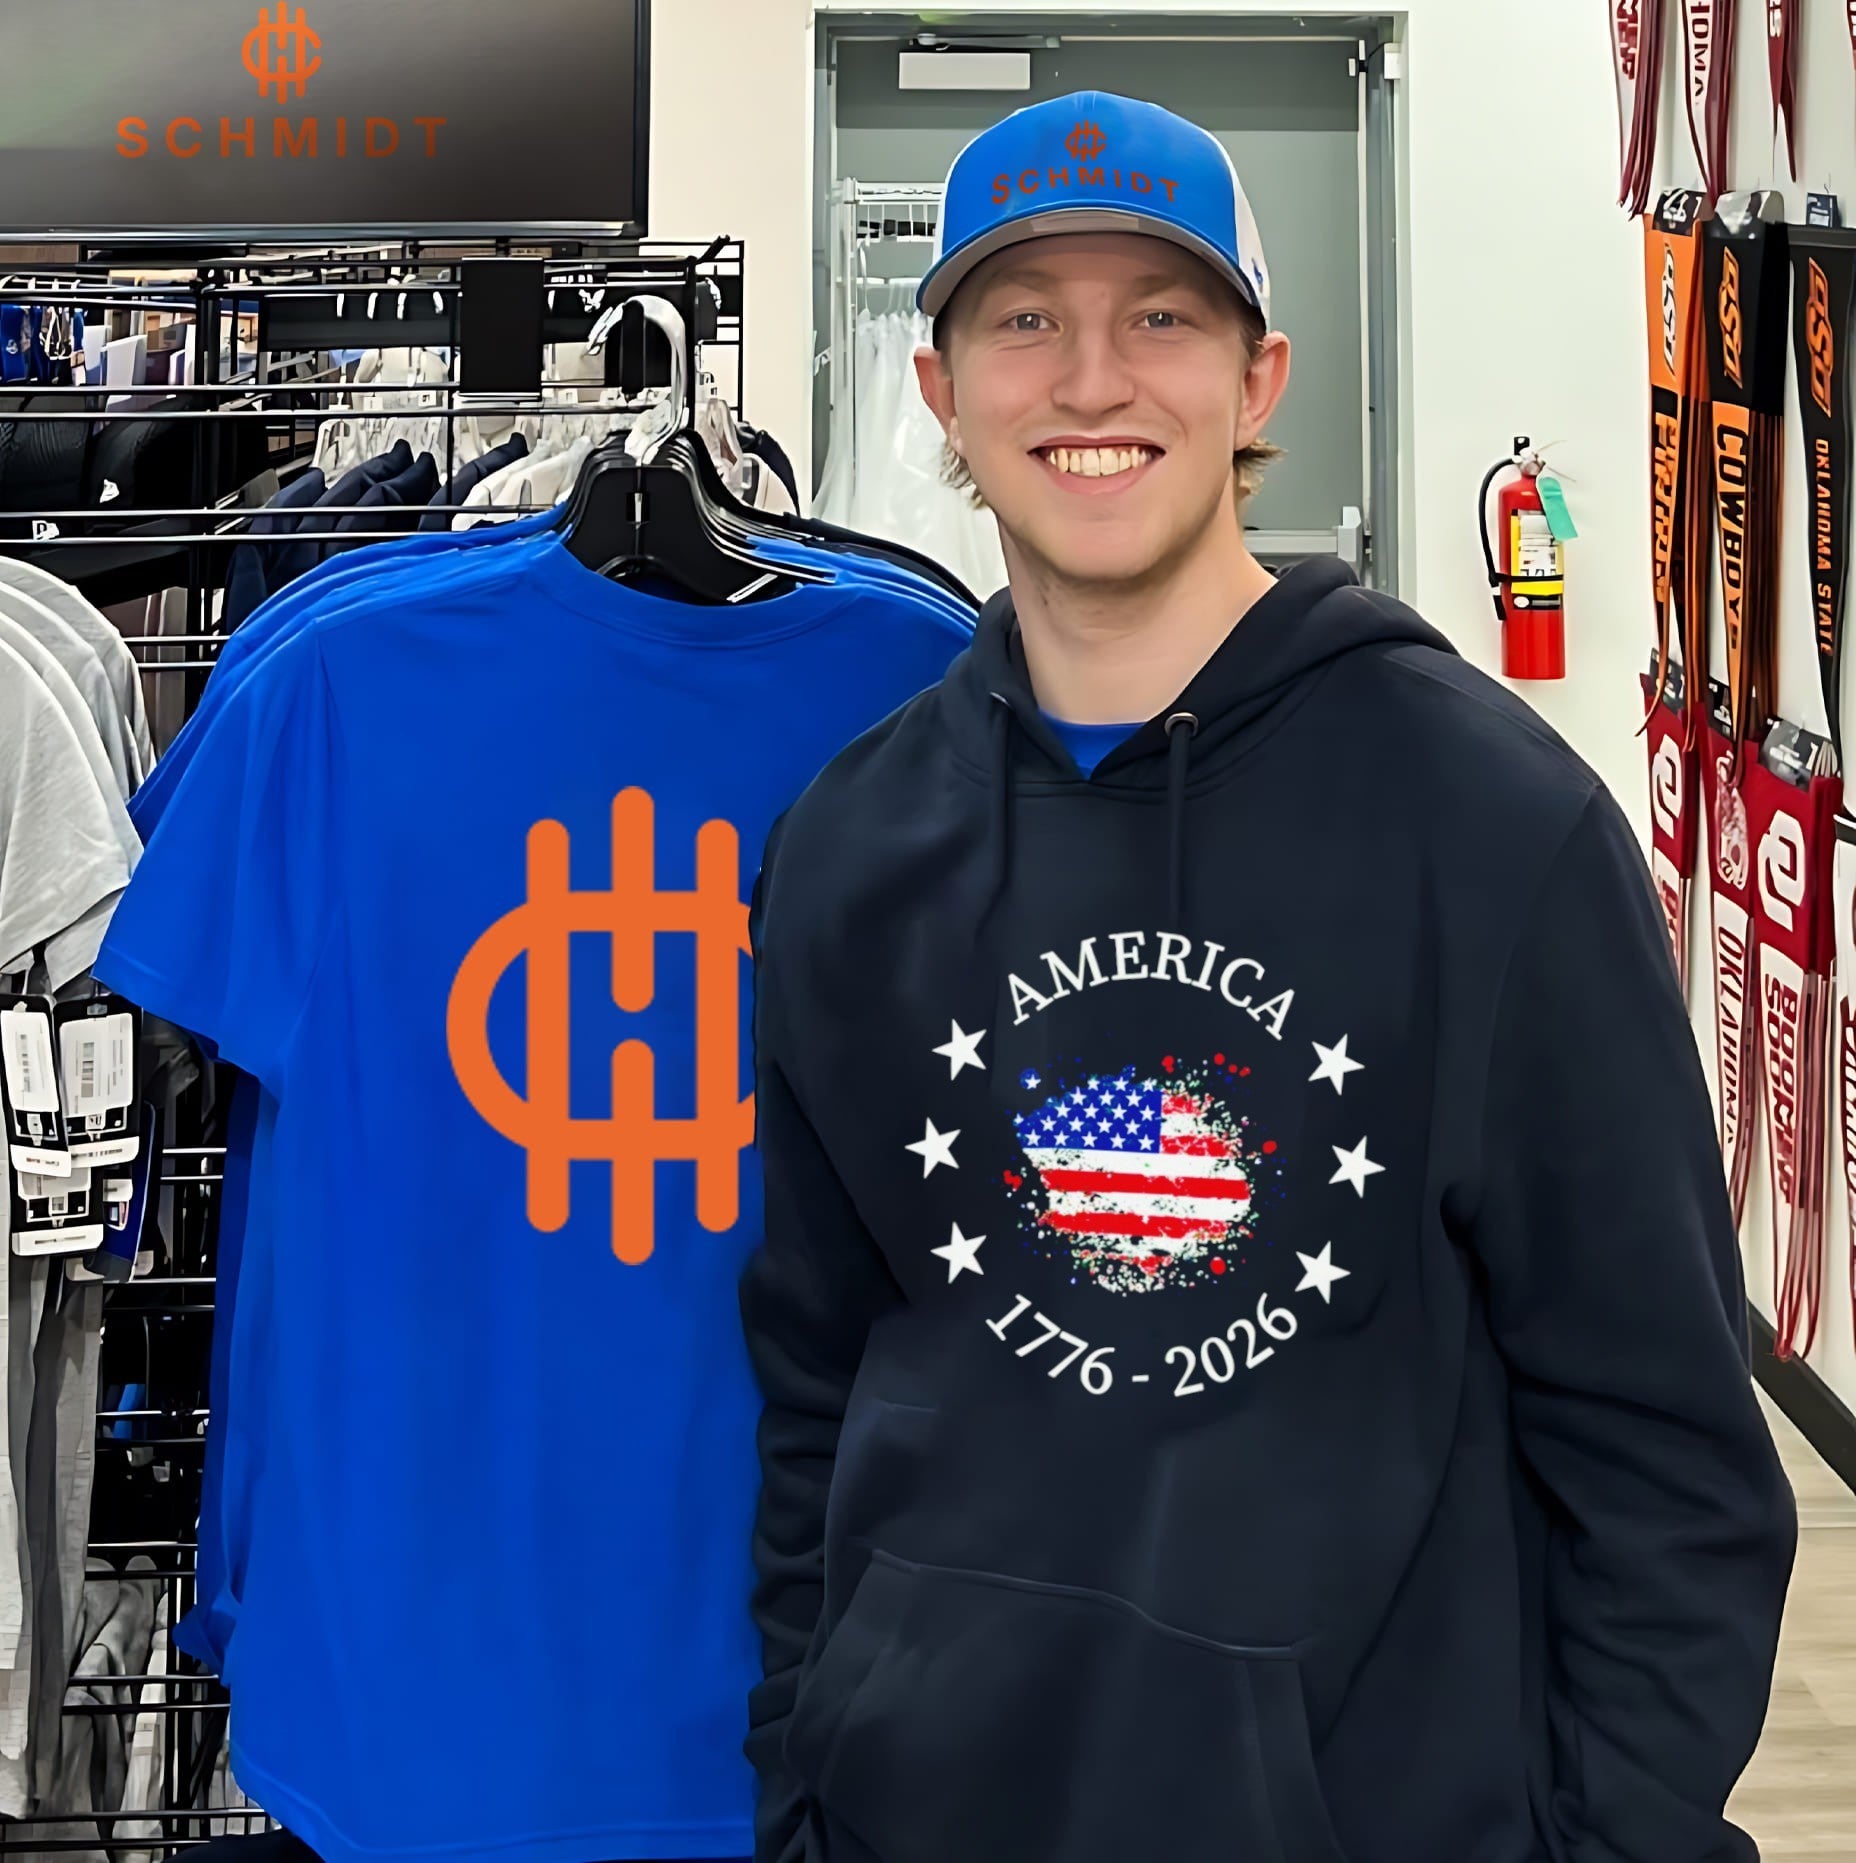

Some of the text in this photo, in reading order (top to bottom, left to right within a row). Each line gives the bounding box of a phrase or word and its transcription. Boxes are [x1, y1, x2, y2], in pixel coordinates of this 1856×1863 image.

[116, 116, 446, 158] SCHMIDT
[991, 166, 1180, 204] SCHMIDT
[1815, 438, 1832, 570] OKLAHOMA
[1008, 931, 1295, 1040] AMERICA
[1717, 925, 1745, 1144] OKLAHOMA
[985, 1294, 1115, 1395] 1776
[1165, 1293, 1298, 1397] 2026
